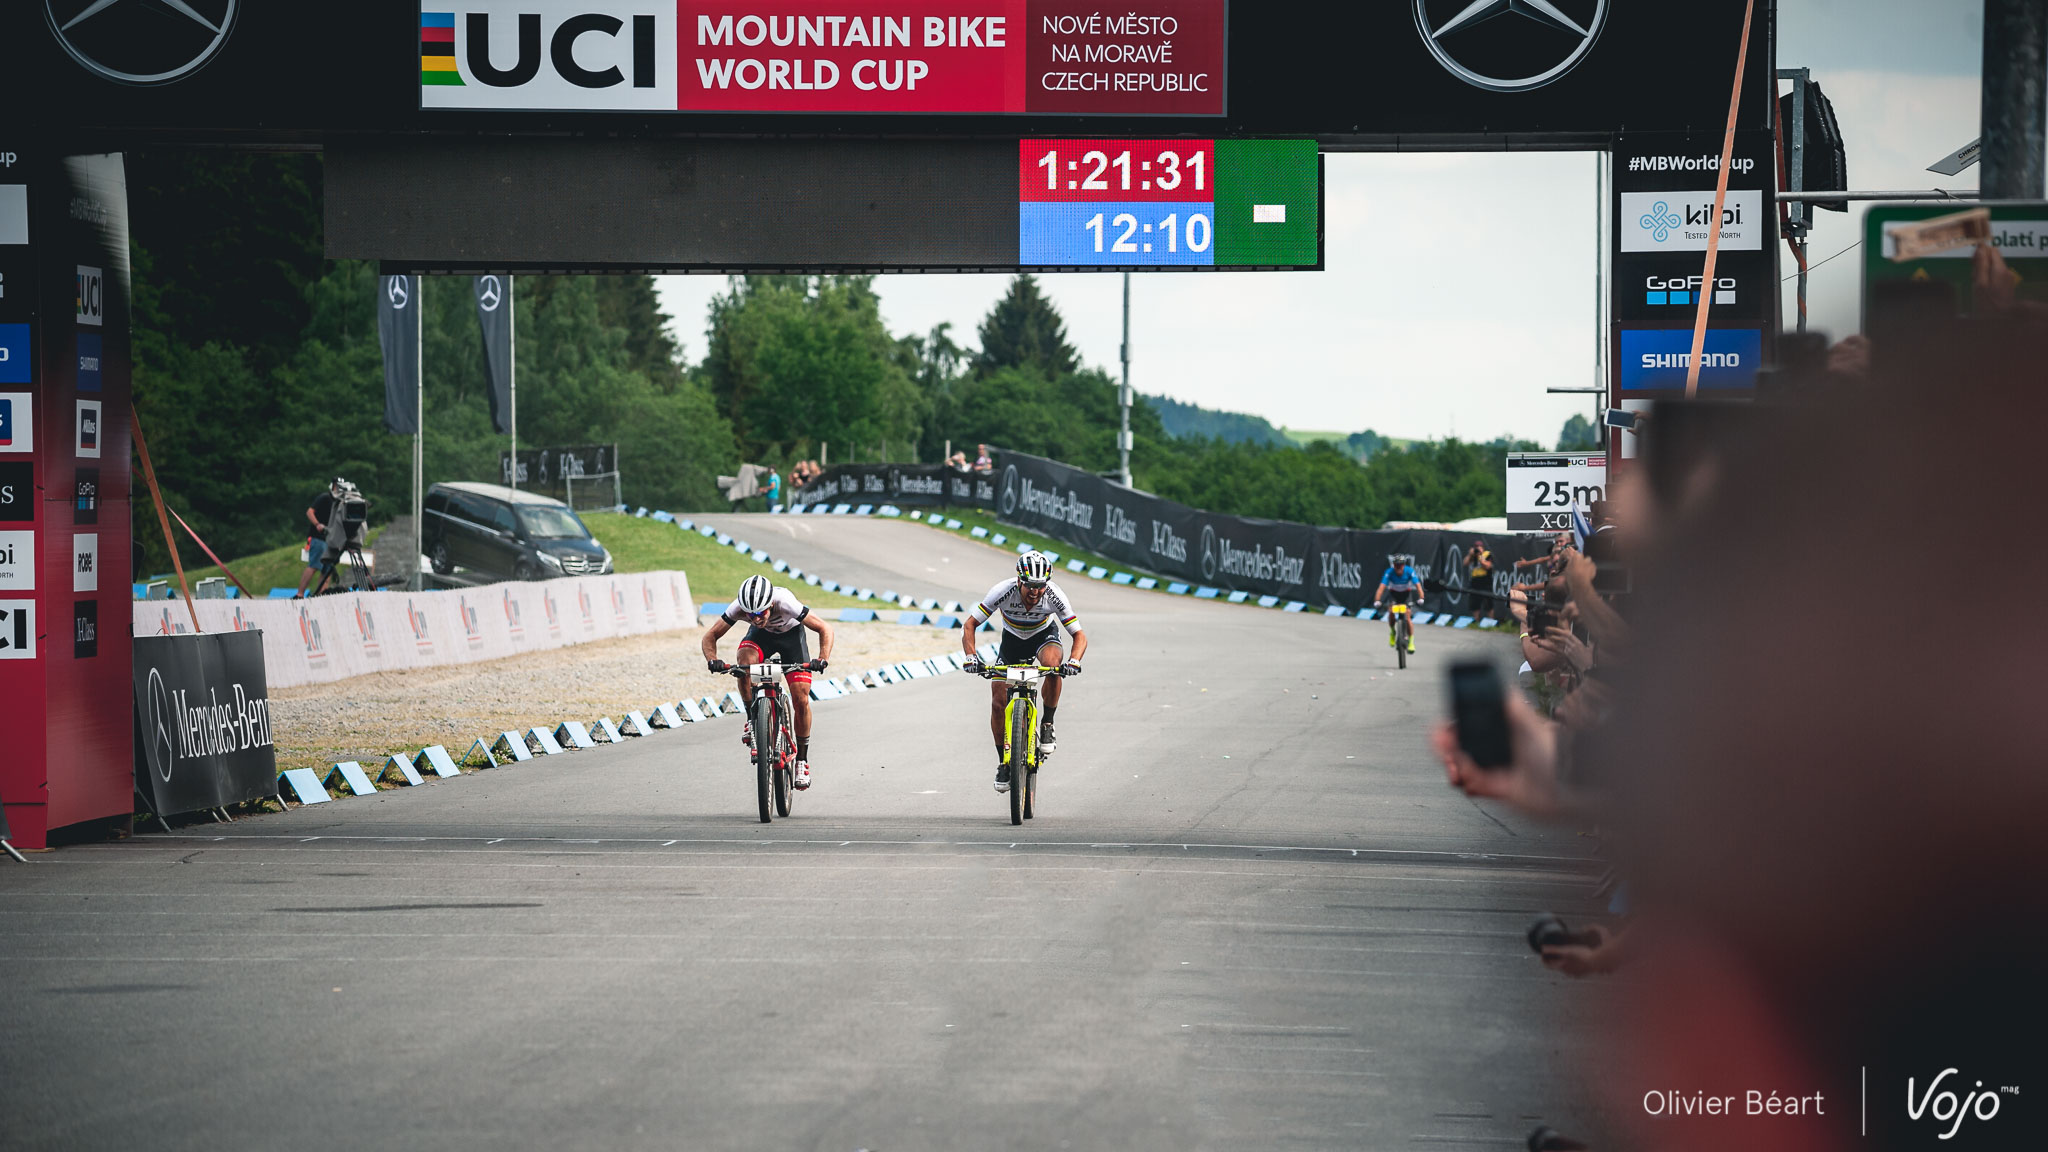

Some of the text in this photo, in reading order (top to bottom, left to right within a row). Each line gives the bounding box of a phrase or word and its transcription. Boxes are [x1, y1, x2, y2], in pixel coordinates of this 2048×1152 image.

[697, 15, 1007, 48] MOUNTAIN BIKE
[1042, 13, 1178, 36] NOVÉ MĚSTO
[466, 12, 656, 89] UCI
[1051, 41, 1173, 64] NA MORAVĚ
[695, 58, 930, 91] WORLD CUP
[1041, 72, 1209, 93] CZECH REPUBLIC
[1038, 150, 1205, 191] 1:21:31
[1085, 213, 1212, 254] 12:10
[1646, 275, 1736, 290] GoPo
[81, 274, 101, 317] UCI
[1641, 353, 1740, 368] SHIMANO
[1571, 459, 1587, 467] UCI
[78, 482, 96, 496] GoPro
[1533, 480, 1603, 507] 25m
[1019, 476, 1094, 530] Mercedes-Benz
[1150, 519, 1187, 564] X-Class
[1218, 537, 1304, 586] Mercedes-Benz
[1318, 551, 1362, 590] X-Class
[759, 664, 773, 677] 11
[1019, 670, 1027, 681] 1
